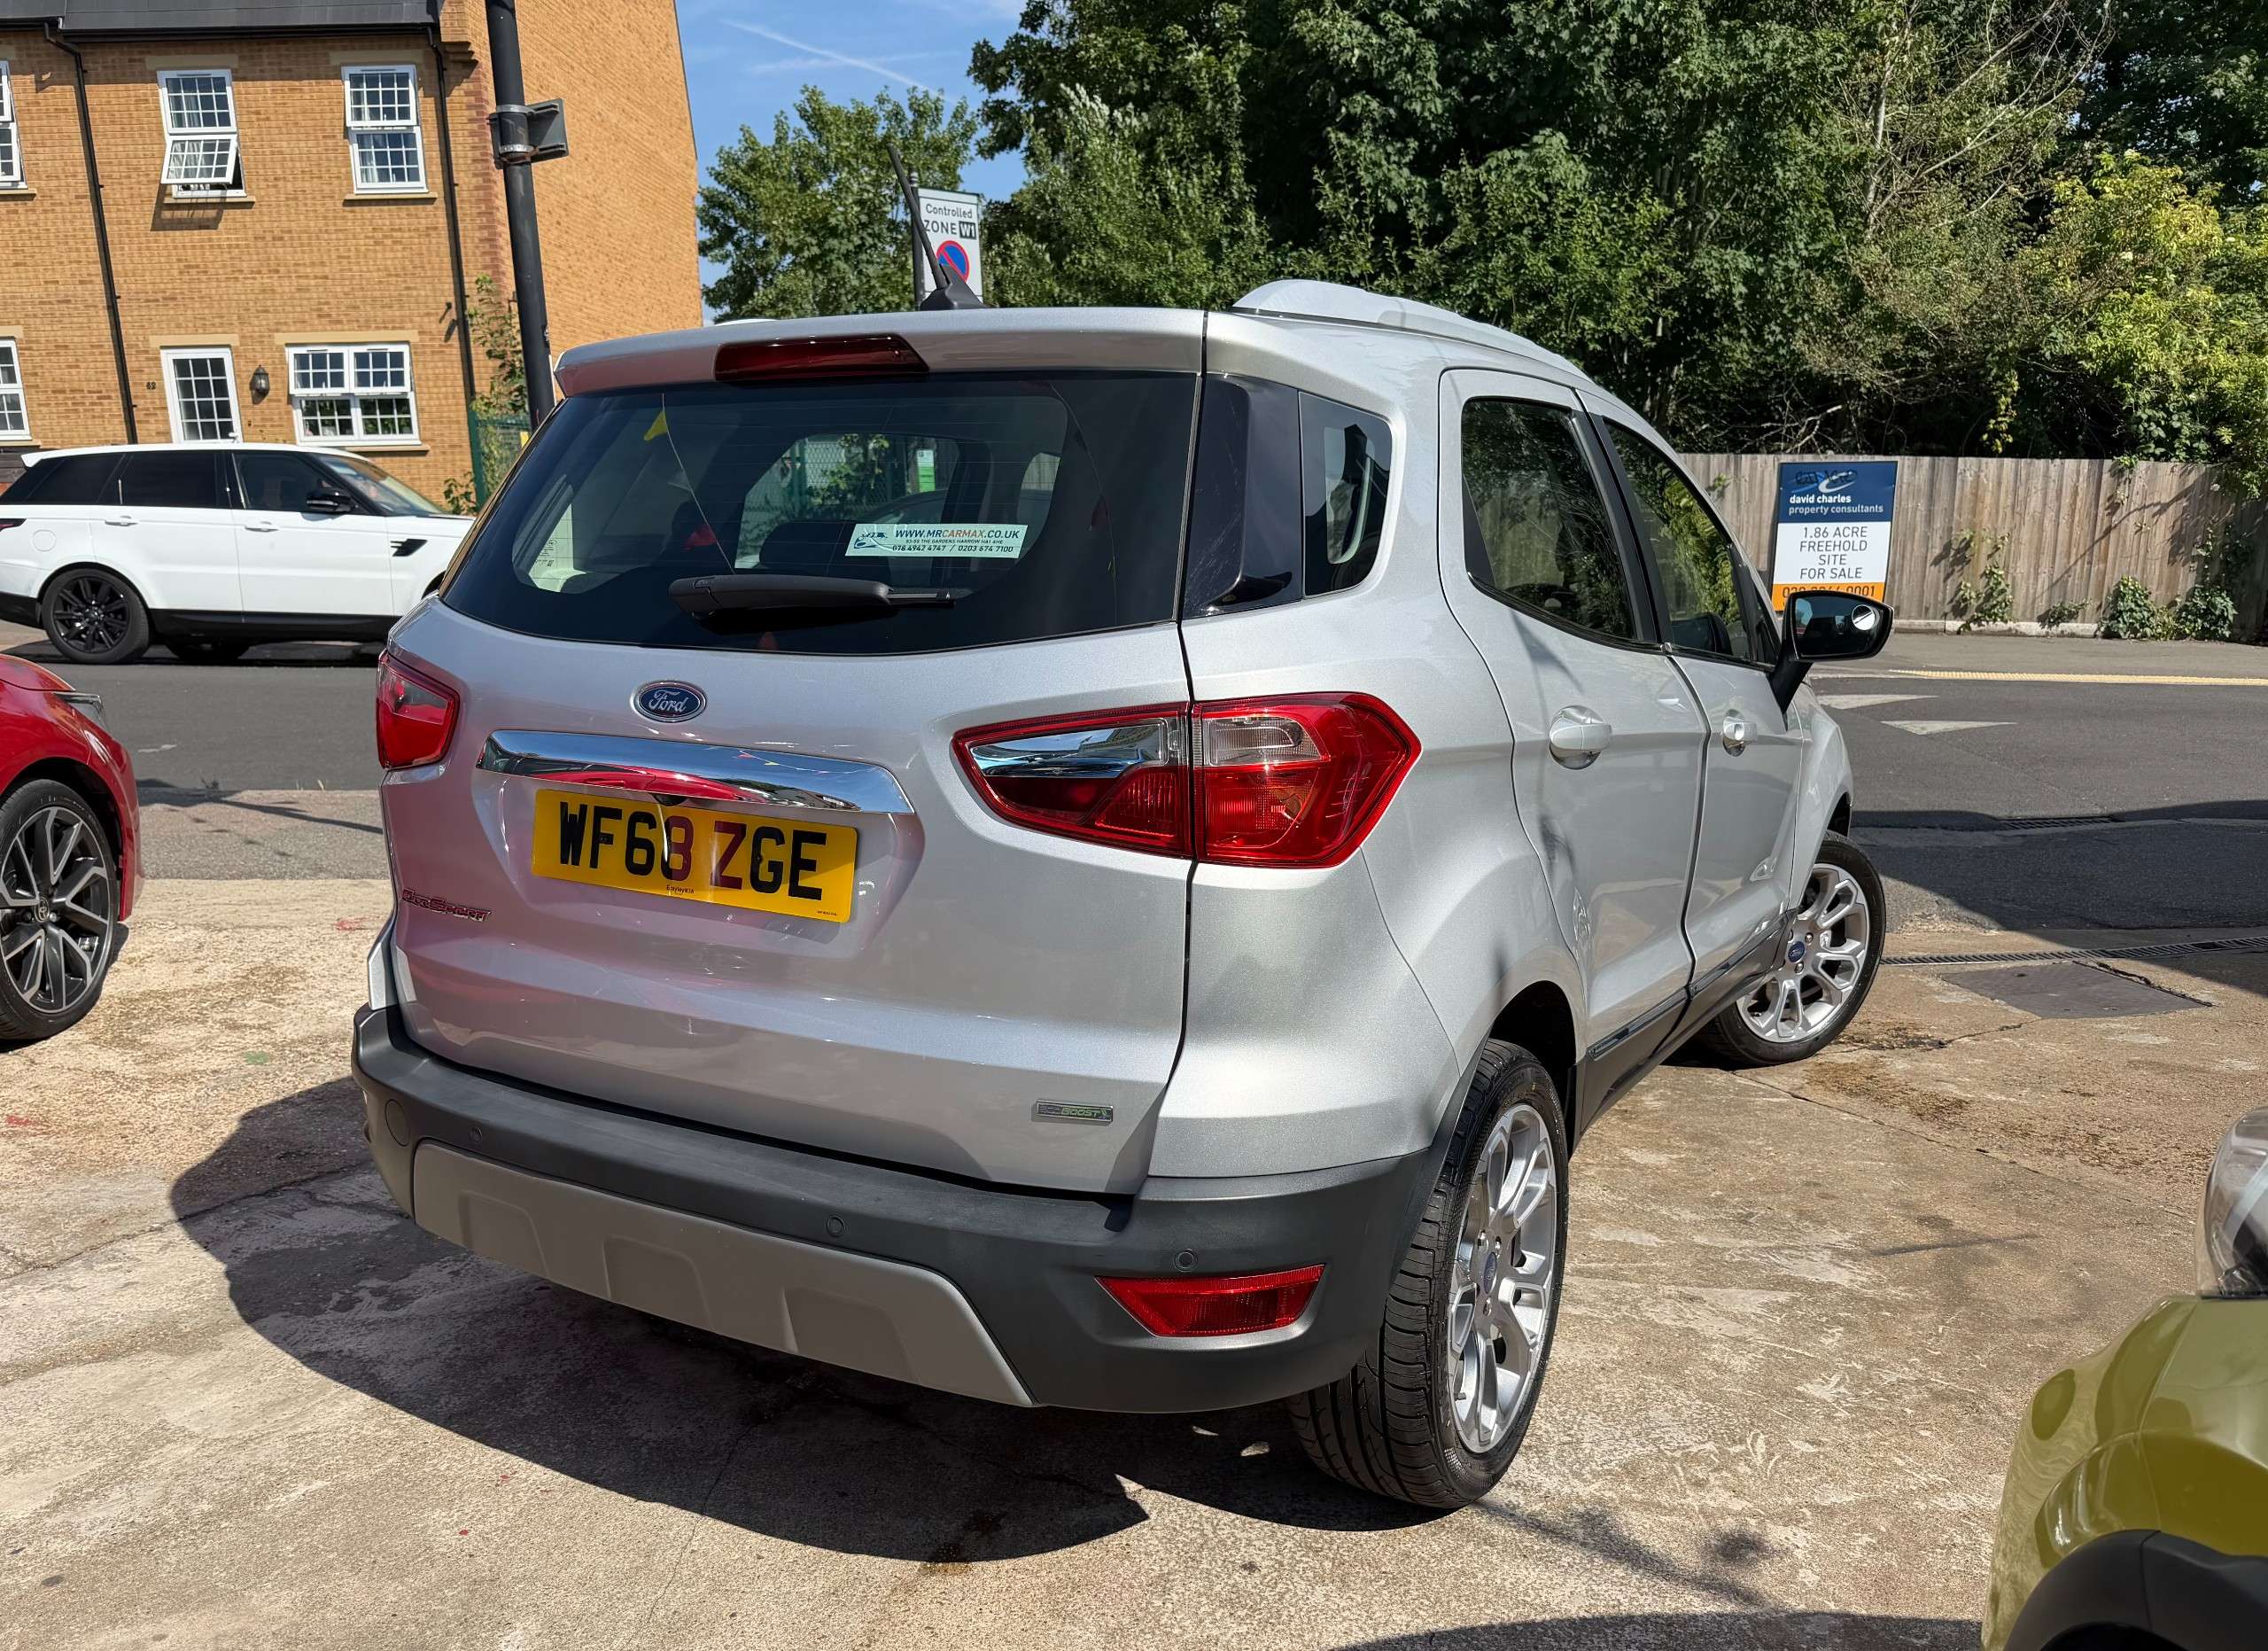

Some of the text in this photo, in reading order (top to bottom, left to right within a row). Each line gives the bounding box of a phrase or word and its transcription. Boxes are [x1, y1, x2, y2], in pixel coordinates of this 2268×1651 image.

[926, 203, 973, 219] Controlled
[923, 220, 957, 235] ZONE
[1790, 494, 1852, 503] david charles
[1788, 504, 1884, 516] property consultants
[895, 529, 1020, 539] WWW.MRCARMAX.CO.UK
[1803, 526, 1868, 539] 1.86 ACRE
[1799, 540, 1868, 552] FREEHOLD
[1818, 554, 1848, 565] SITE
[1799, 567, 1862, 580] FOR SALE
[649, 689, 689, 713] Ford
[559, 801, 827, 900] WF68 ZGE
